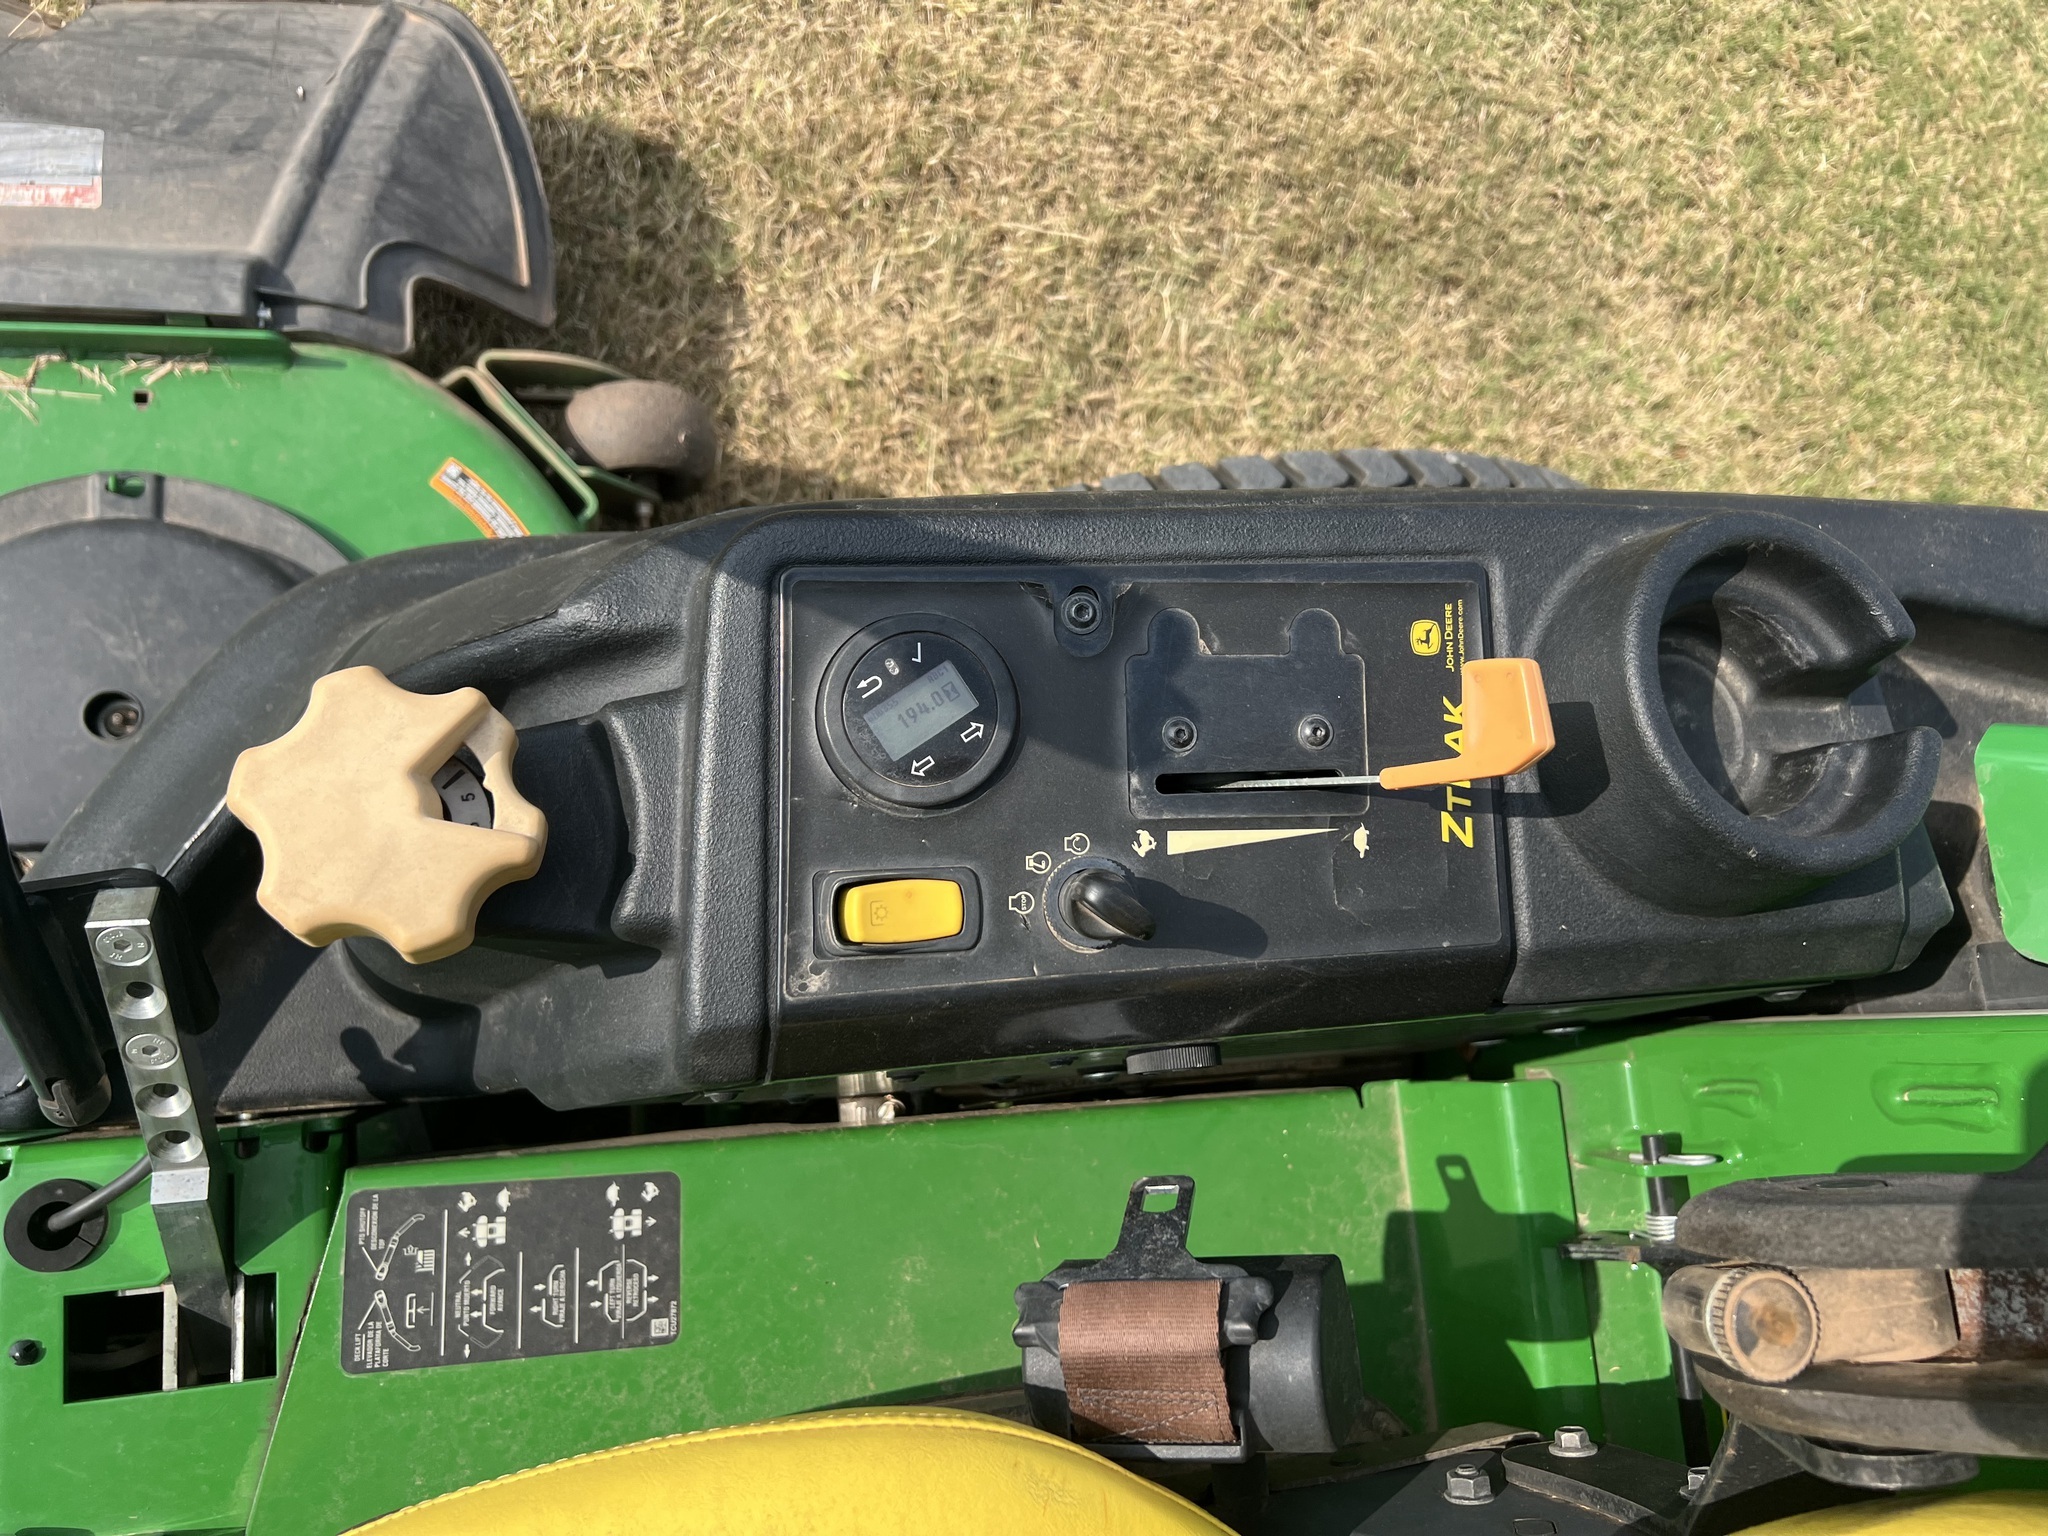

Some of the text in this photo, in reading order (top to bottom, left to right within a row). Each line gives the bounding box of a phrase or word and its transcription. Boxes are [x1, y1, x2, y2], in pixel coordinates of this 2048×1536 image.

[1444, 603, 1454, 673] JOHN DEERE
[898, 691, 944, 728] 194.0
[1439, 695, 1474, 849] ZTAK
[461, 792, 476, 802] 5
[372, 1194, 379, 1202] LA
[454, 1291, 462, 1318] NEUTRAL
[489, 1285, 497, 1315] FORWARD
[367, 1321, 374, 1329] LA
[367, 1330, 374, 1338] DE
[354, 1333, 362, 1346] LIFT
[374, 1321, 382, 1368] PLATAFORMA DE
[382, 1348, 390, 1367] CORTE
